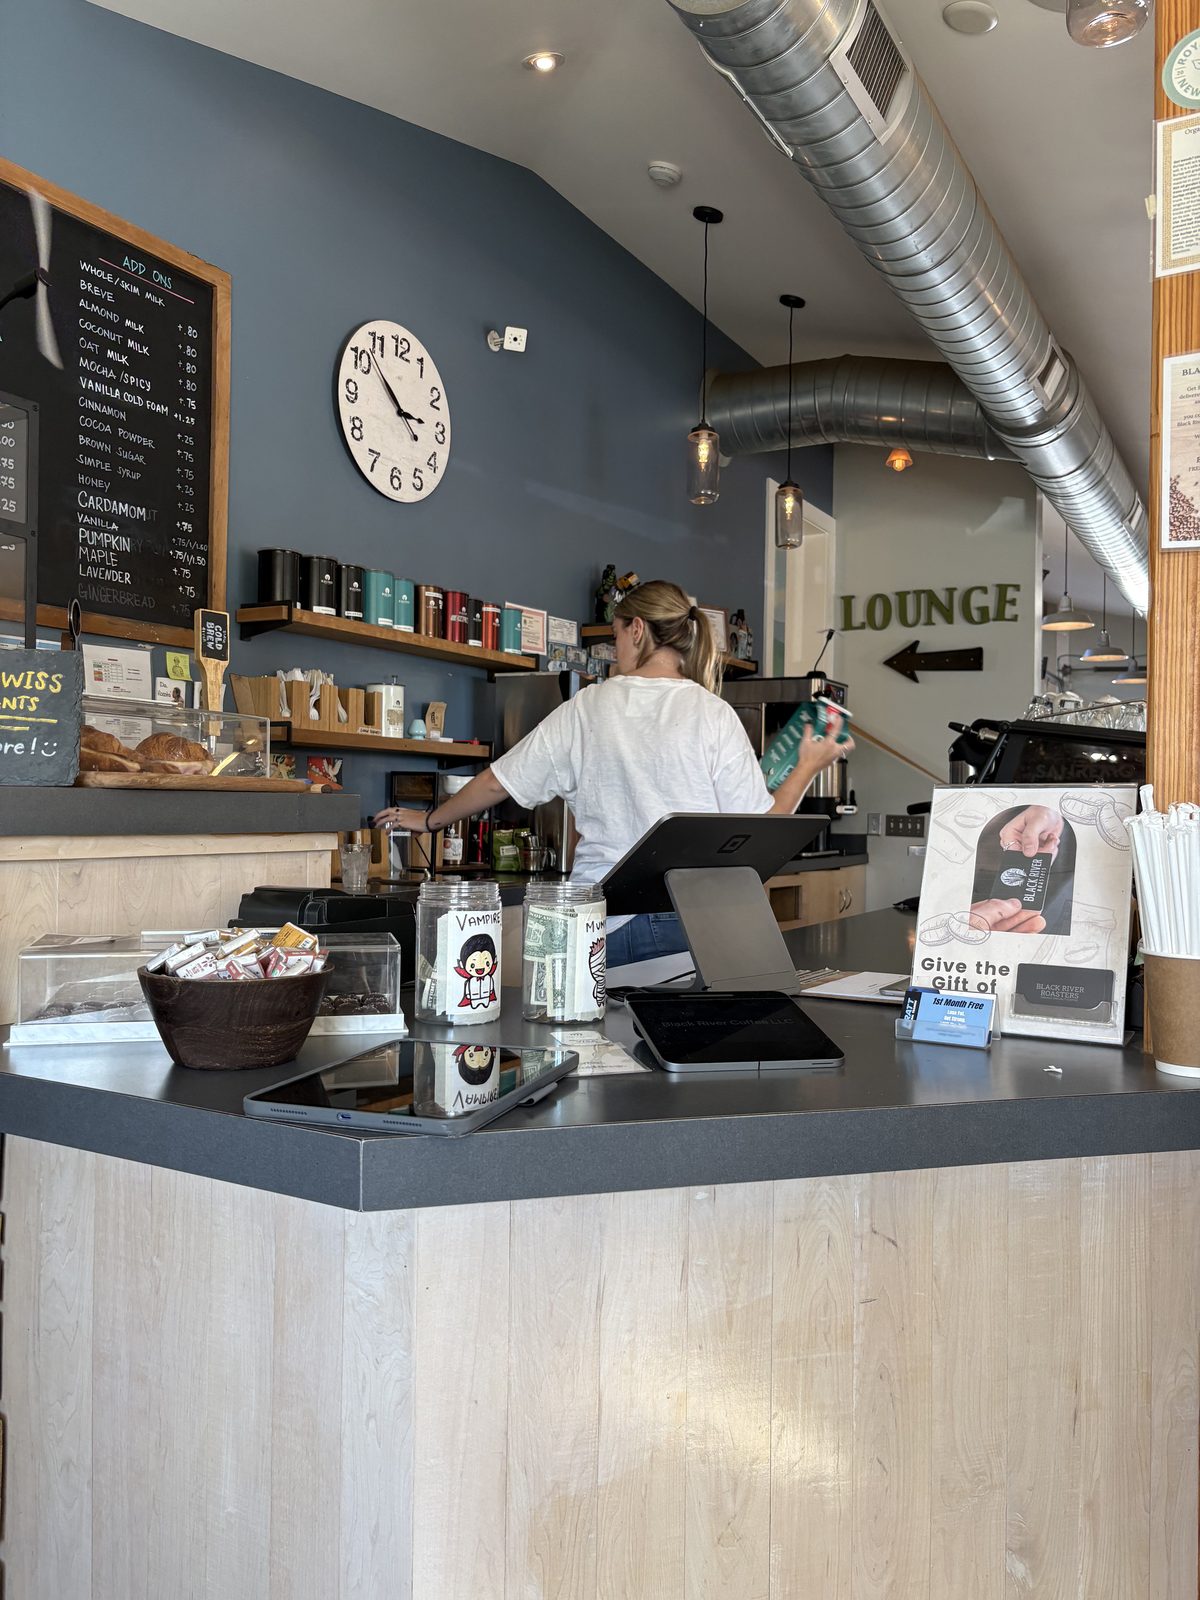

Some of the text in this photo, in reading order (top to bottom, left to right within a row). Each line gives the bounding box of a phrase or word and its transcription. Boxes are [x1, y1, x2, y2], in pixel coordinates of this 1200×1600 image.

[79, 260, 165, 307] WHOLE/SKIM MILK
[123, 256, 172, 289] ADD ONS
[80, 279, 198, 338] BREVE +.80
[79, 298, 197, 358] ALMOND MILK +.80
[79, 318, 197, 374] COCONUT MILK +.80
[368, 331, 385, 358] 11
[392, 333, 411, 364] 12
[79, 337, 197, 392] OAT MILK +.80
[350, 346, 372, 375] 10
[417, 357, 424, 379] 1
[79, 376, 195, 425] VANILLA COLD FOAM +1.25
[178, 397, 197, 410] +.75
[346, 378, 359, 404] 9
[430, 386, 441, 411] 2
[78, 396, 194, 446] CINNAMON +.25
[351, 416, 363, 442] 8
[434, 421, 446, 445] 3
[79, 415, 194, 463] COCOA POWDER +.75
[78, 434, 194, 481] BROWN SUGAR +.75
[368, 448, 381, 473] 7
[427, 451, 437, 474] 4
[76, 454, 194, 496] SIMPLE SYRUP +.25
[389, 466, 402, 491] 6
[412, 467, 424, 492] 5
[78, 473, 195, 513] HONEY +.25
[77, 490, 146, 521] CARDAMOM
[176, 521, 193, 533] +.75
[77, 511, 119, 531] VANILLA
[79, 527, 131, 553] PUMPKIN
[79, 546, 118, 567] MAPLE
[172, 567, 192, 579] +.75
[79, 563, 196, 598] LAVENDER +.75
[78, 582, 156, 609] GINGERBREAD
[840, 584, 1021, 631] LOUNGE
[206, 621, 215, 650] BREW
[214, 625, 223, 650] COLD
[2, 671, 64, 693] WISS
[0, 695, 40, 712] NTS
[1023, 858, 1043, 902] BLACK RIVER
[456, 912, 501, 931] VAMPIRE
[921, 957, 1010, 976] Give the
[932, 975, 997, 994] Gift of
[1036, 983, 1085, 993] BLACK RIVER
[1040, 990, 1079, 999] ROASTERS
[933, 997, 985, 1010] 1st Month Free
